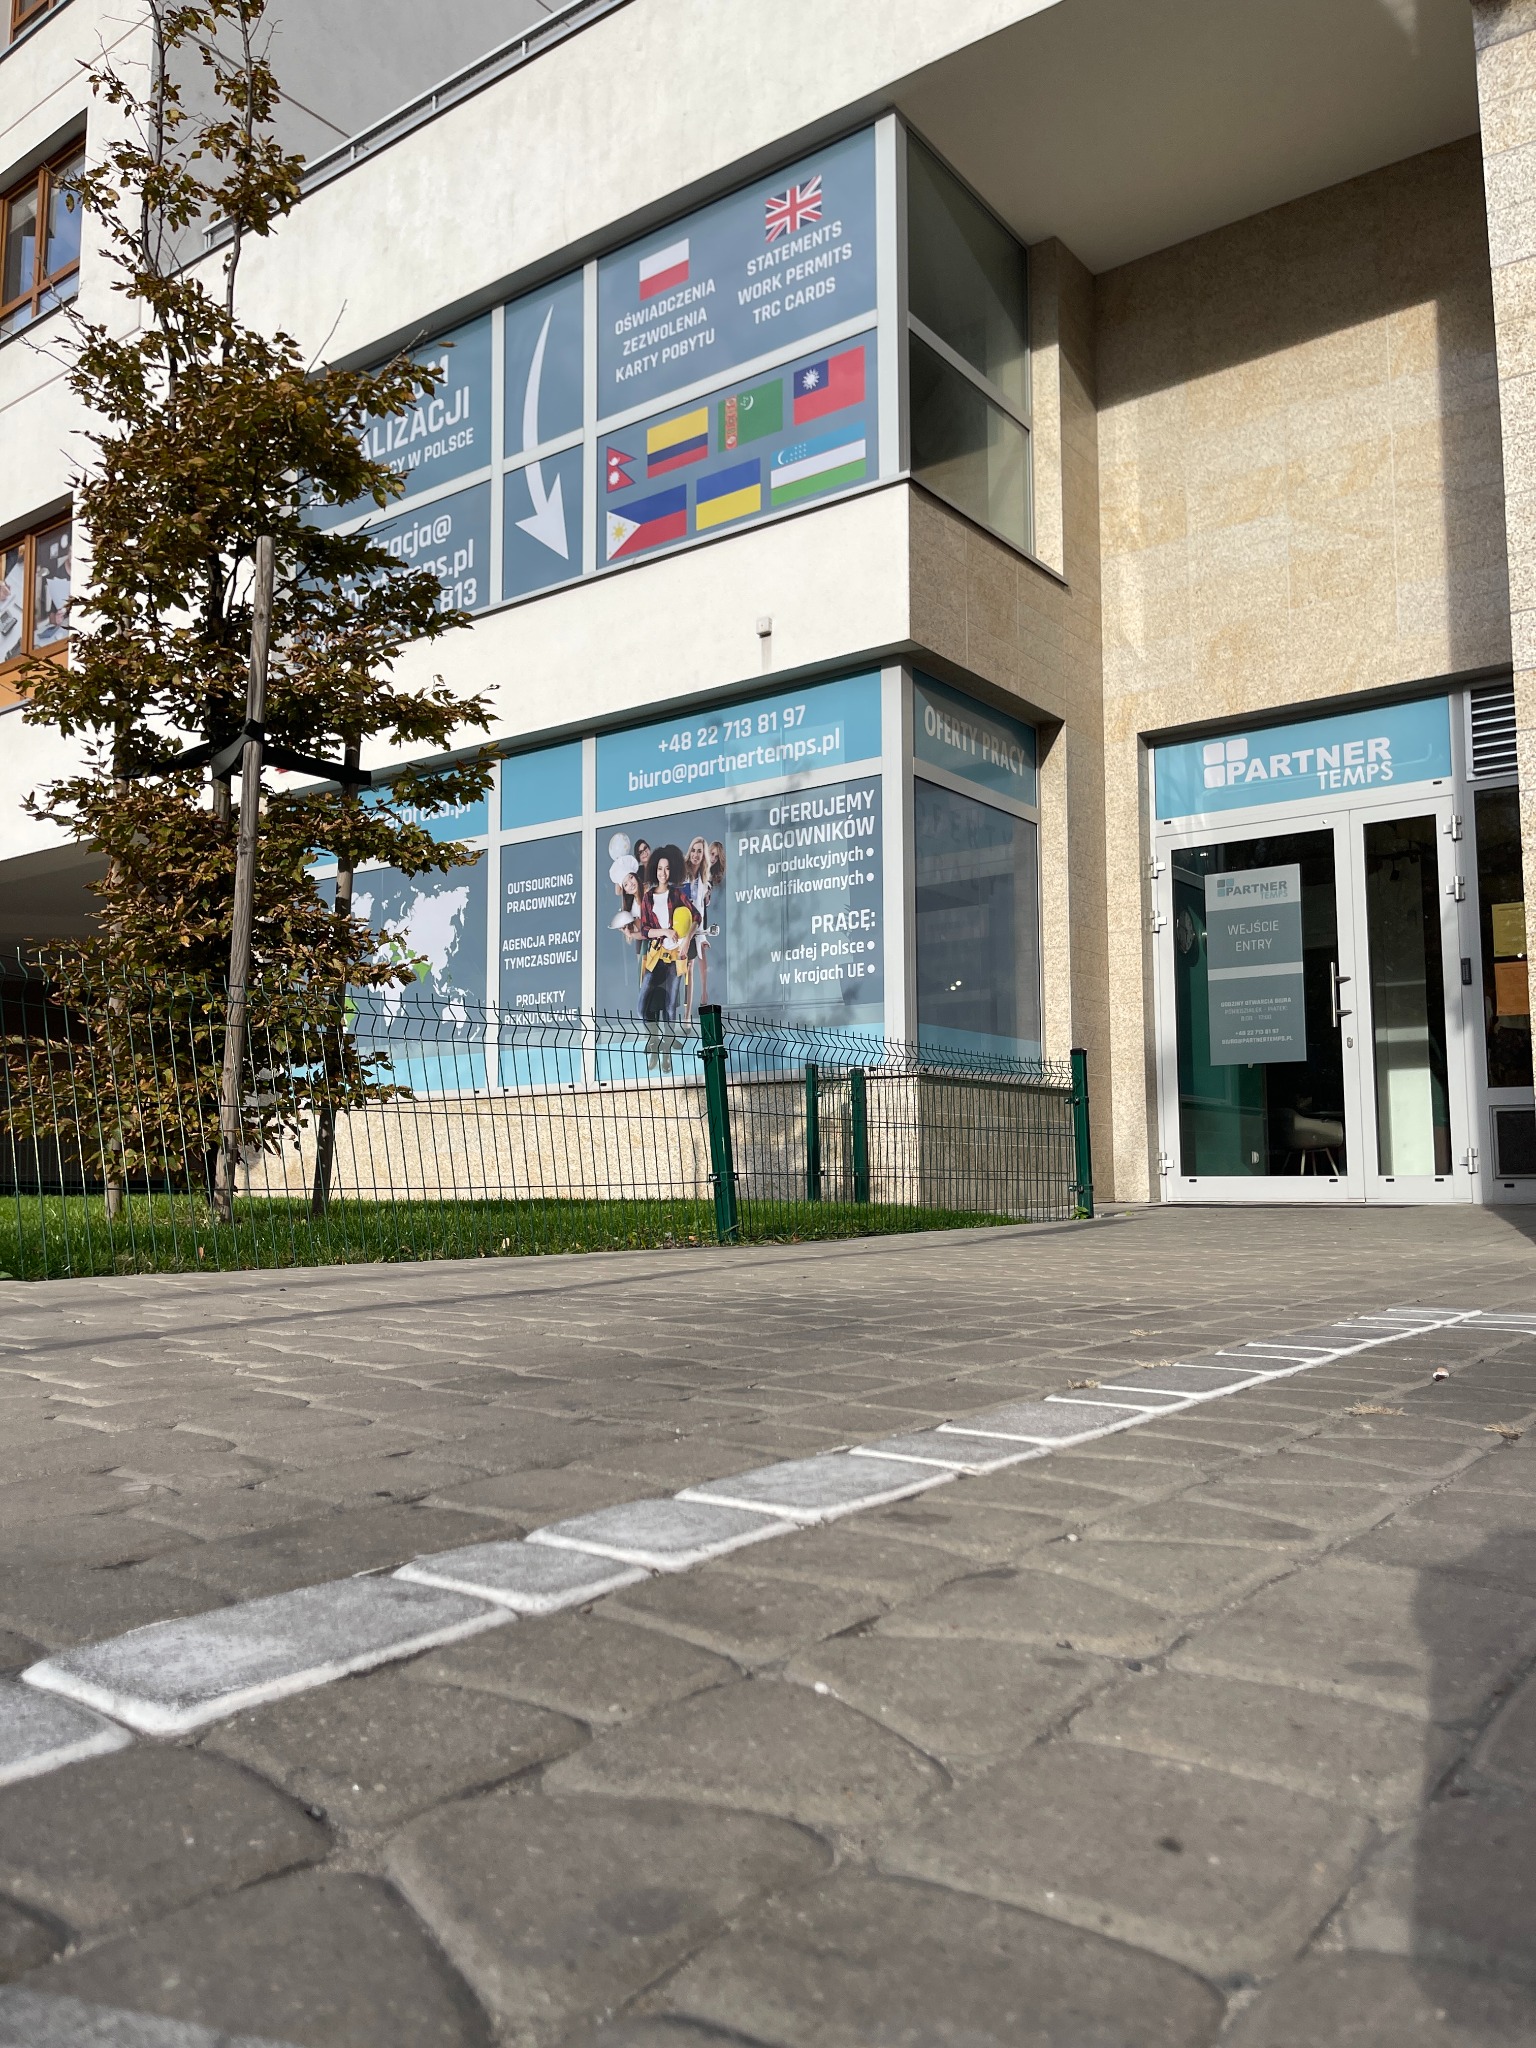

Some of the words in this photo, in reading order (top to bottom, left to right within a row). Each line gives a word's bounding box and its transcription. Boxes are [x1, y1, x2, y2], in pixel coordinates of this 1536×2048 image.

[747, 220, 842, 276] STATEMENTS
[738, 275, 782, 306] WORK
[786, 243, 852, 282] PERMITS
[615, 278, 716, 336] OŚWIADCZENIA
[752, 300, 780, 324] TRC
[784, 277, 836, 312] CARDS
[622, 307, 708, 356] ZEZWOLENIA
[616, 354, 658, 383] KARTY
[662, 328, 716, 364] POBYTU
[360, 386, 470, 460] ALIZACJI
[408, 449, 421, 470] W
[424, 427, 474, 462] POLSCE
[658, 732, 691, 753] +48
[697, 726, 718, 748] 22
[723, 718, 752, 742] 713
[758, 711, 778, 734] 81
[783, 705, 806, 728] 97
[924, 705, 978, 756] OFERTY
[982, 732, 1024, 776] PRACY
[628, 728, 840, 792] biuro@partnertemps.pl
[1226, 736, 1392, 786] PARTNER
[1317, 761, 1394, 790] TEMPS
[769, 790, 874, 826] OFERUJEMY
[738, 816, 875, 856] PRACOWNIKÓW
[767, 846, 864, 877] produkcyjnych
[507, 873, 574, 895] OUTSOURCING
[735, 872, 864, 904] wykwalifikowanych
[1226, 880, 1288, 896] PARTNER
[1260, 890, 1288, 900] TEMPS
[506, 892, 577, 914] PRACOWNICZY
[811, 908, 876, 934] PRACĘ:
[1228, 920, 1280, 936] WEJŚCIE
[502, 933, 546, 952] AGENCJA
[548, 930, 581, 947] PRACY
[770, 949, 784, 963] w
[784, 942, 817, 962] całej
[820, 939, 865, 958] Polsce
[1235, 938, 1272, 952] ENTRY
[504, 950, 578, 970] TYMCZASOWEJ
[780, 972, 792, 985] w
[794, 963, 844, 985] krajach
[847, 962, 865, 978] UE
[516, 990, 566, 1006] PROJEKTY
[504, 1008, 578, 1026] REKRUTACYJNE
